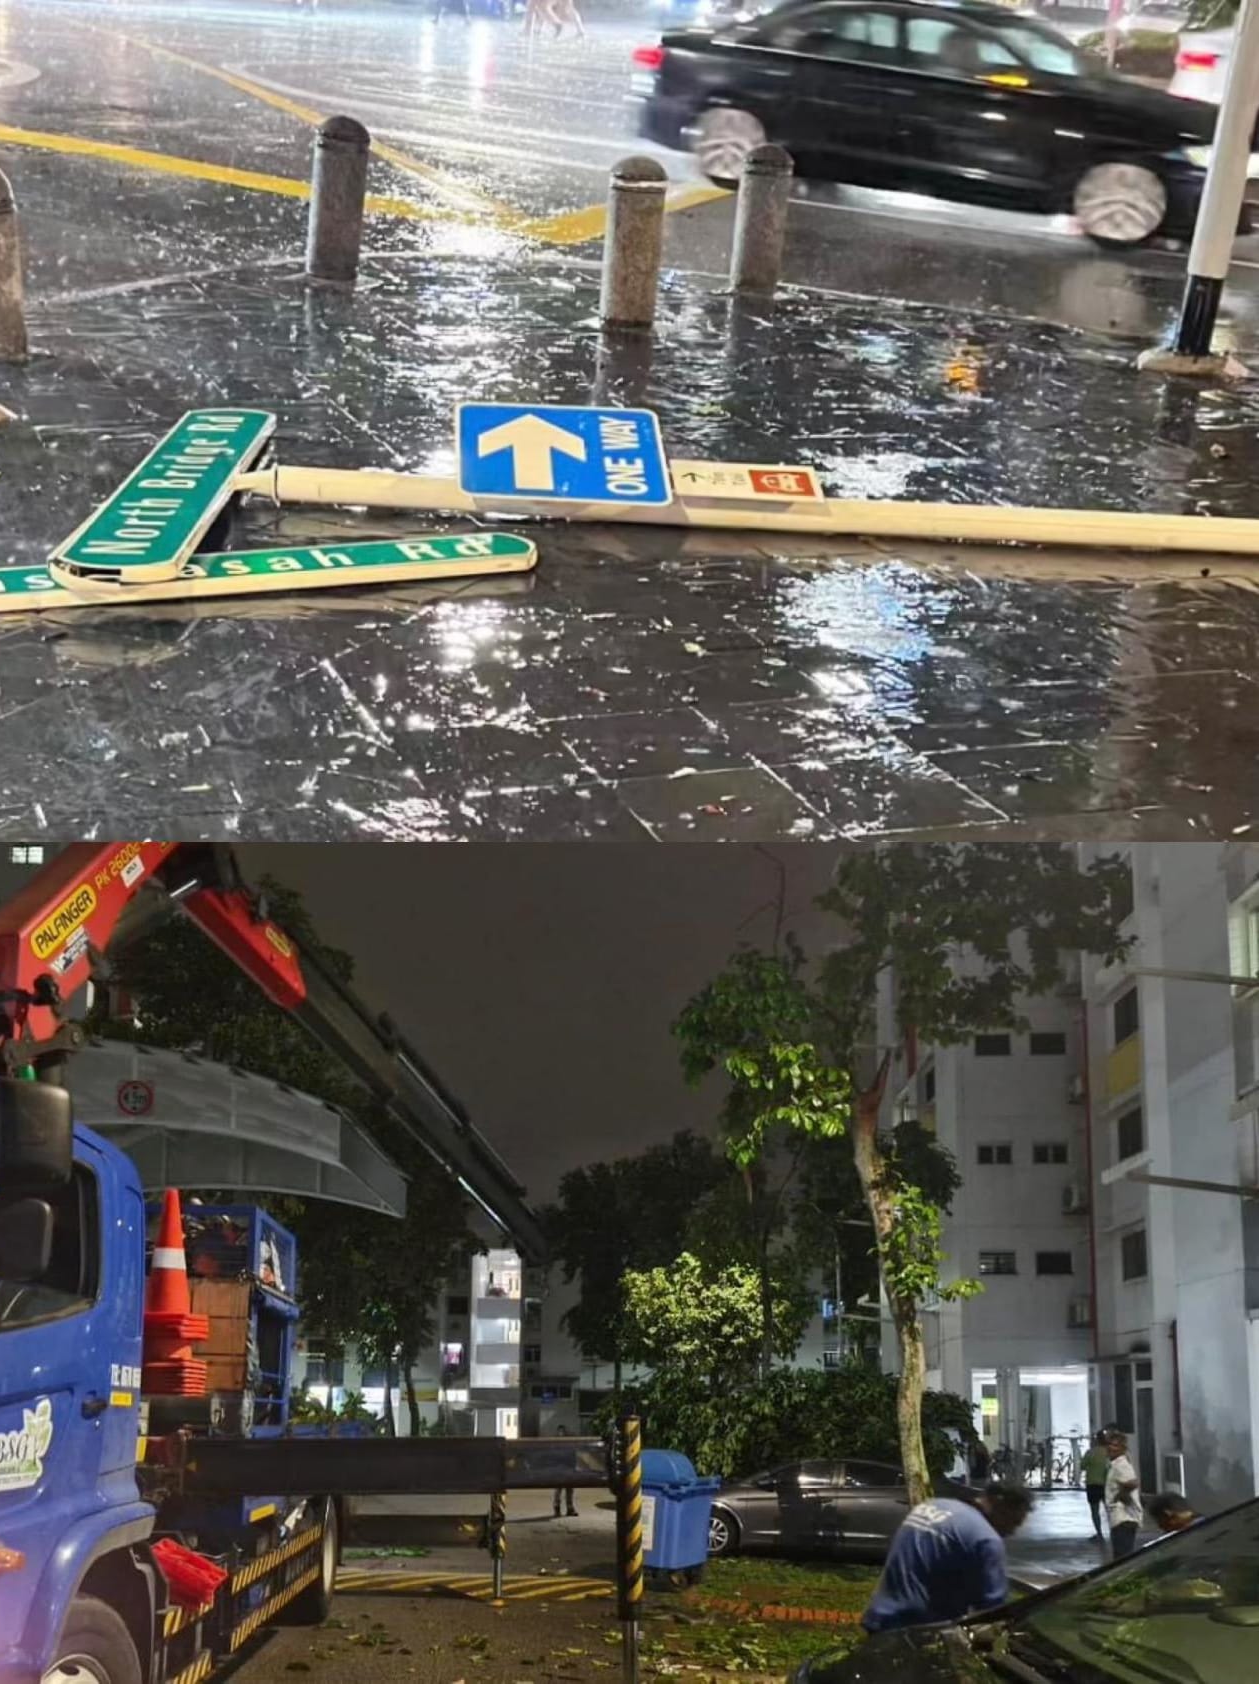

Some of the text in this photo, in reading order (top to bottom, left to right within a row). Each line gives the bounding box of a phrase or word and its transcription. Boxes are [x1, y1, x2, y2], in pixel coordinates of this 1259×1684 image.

[81, 416, 245, 555] North Bridge Rd
[599, 416, 649, 496] ONE WAY
[178, 550, 355, 578] asah
[394, 536, 494, 560] Rd
[94, 868, 111, 890] PK
[34, 889, 93, 953] PALFINGER
